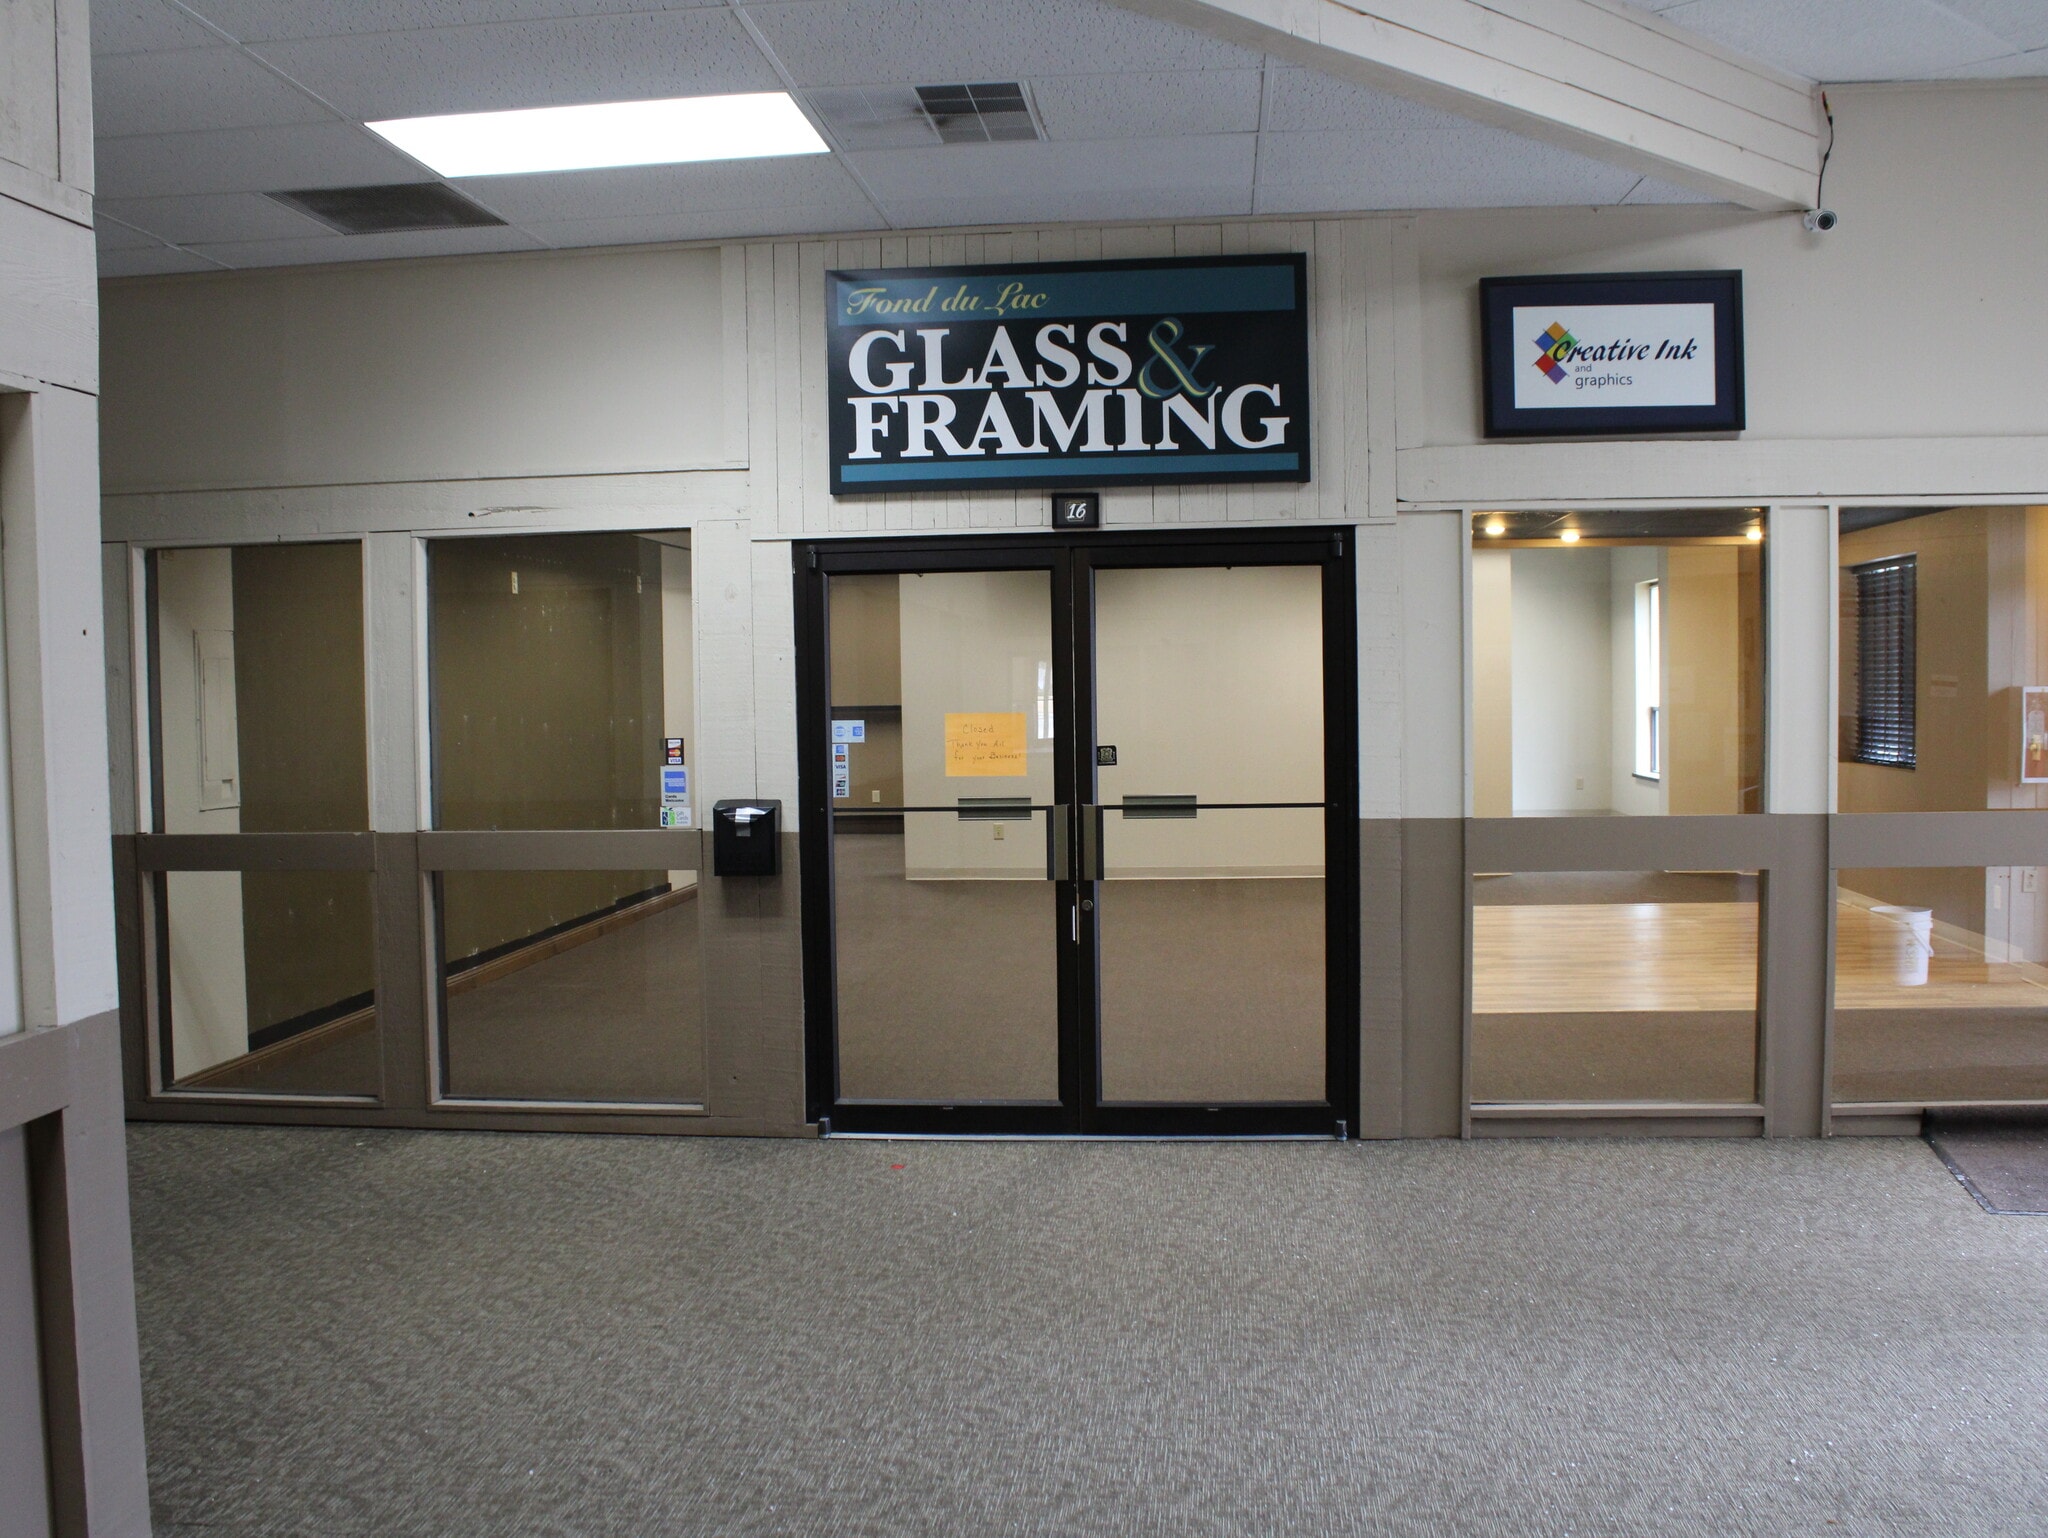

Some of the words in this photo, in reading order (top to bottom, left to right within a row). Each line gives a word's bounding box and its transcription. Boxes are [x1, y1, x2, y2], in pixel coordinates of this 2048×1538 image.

[846, 286, 938, 316] Fond
[941, 285, 981, 312] du
[984, 281, 1047, 316] Lac
[848, 322, 1132, 394] GLASS
[1138, 316, 1216, 399] &
[1552, 338, 1650, 363] Creative
[1655, 337, 1698, 360] Ink
[1575, 364, 1592, 372] and
[1575, 373, 1633, 389] graphics
[847, 383, 1290, 460] FRAMING
[1066, 502, 1087, 519] 16
[962, 723, 994, 735] Closed
